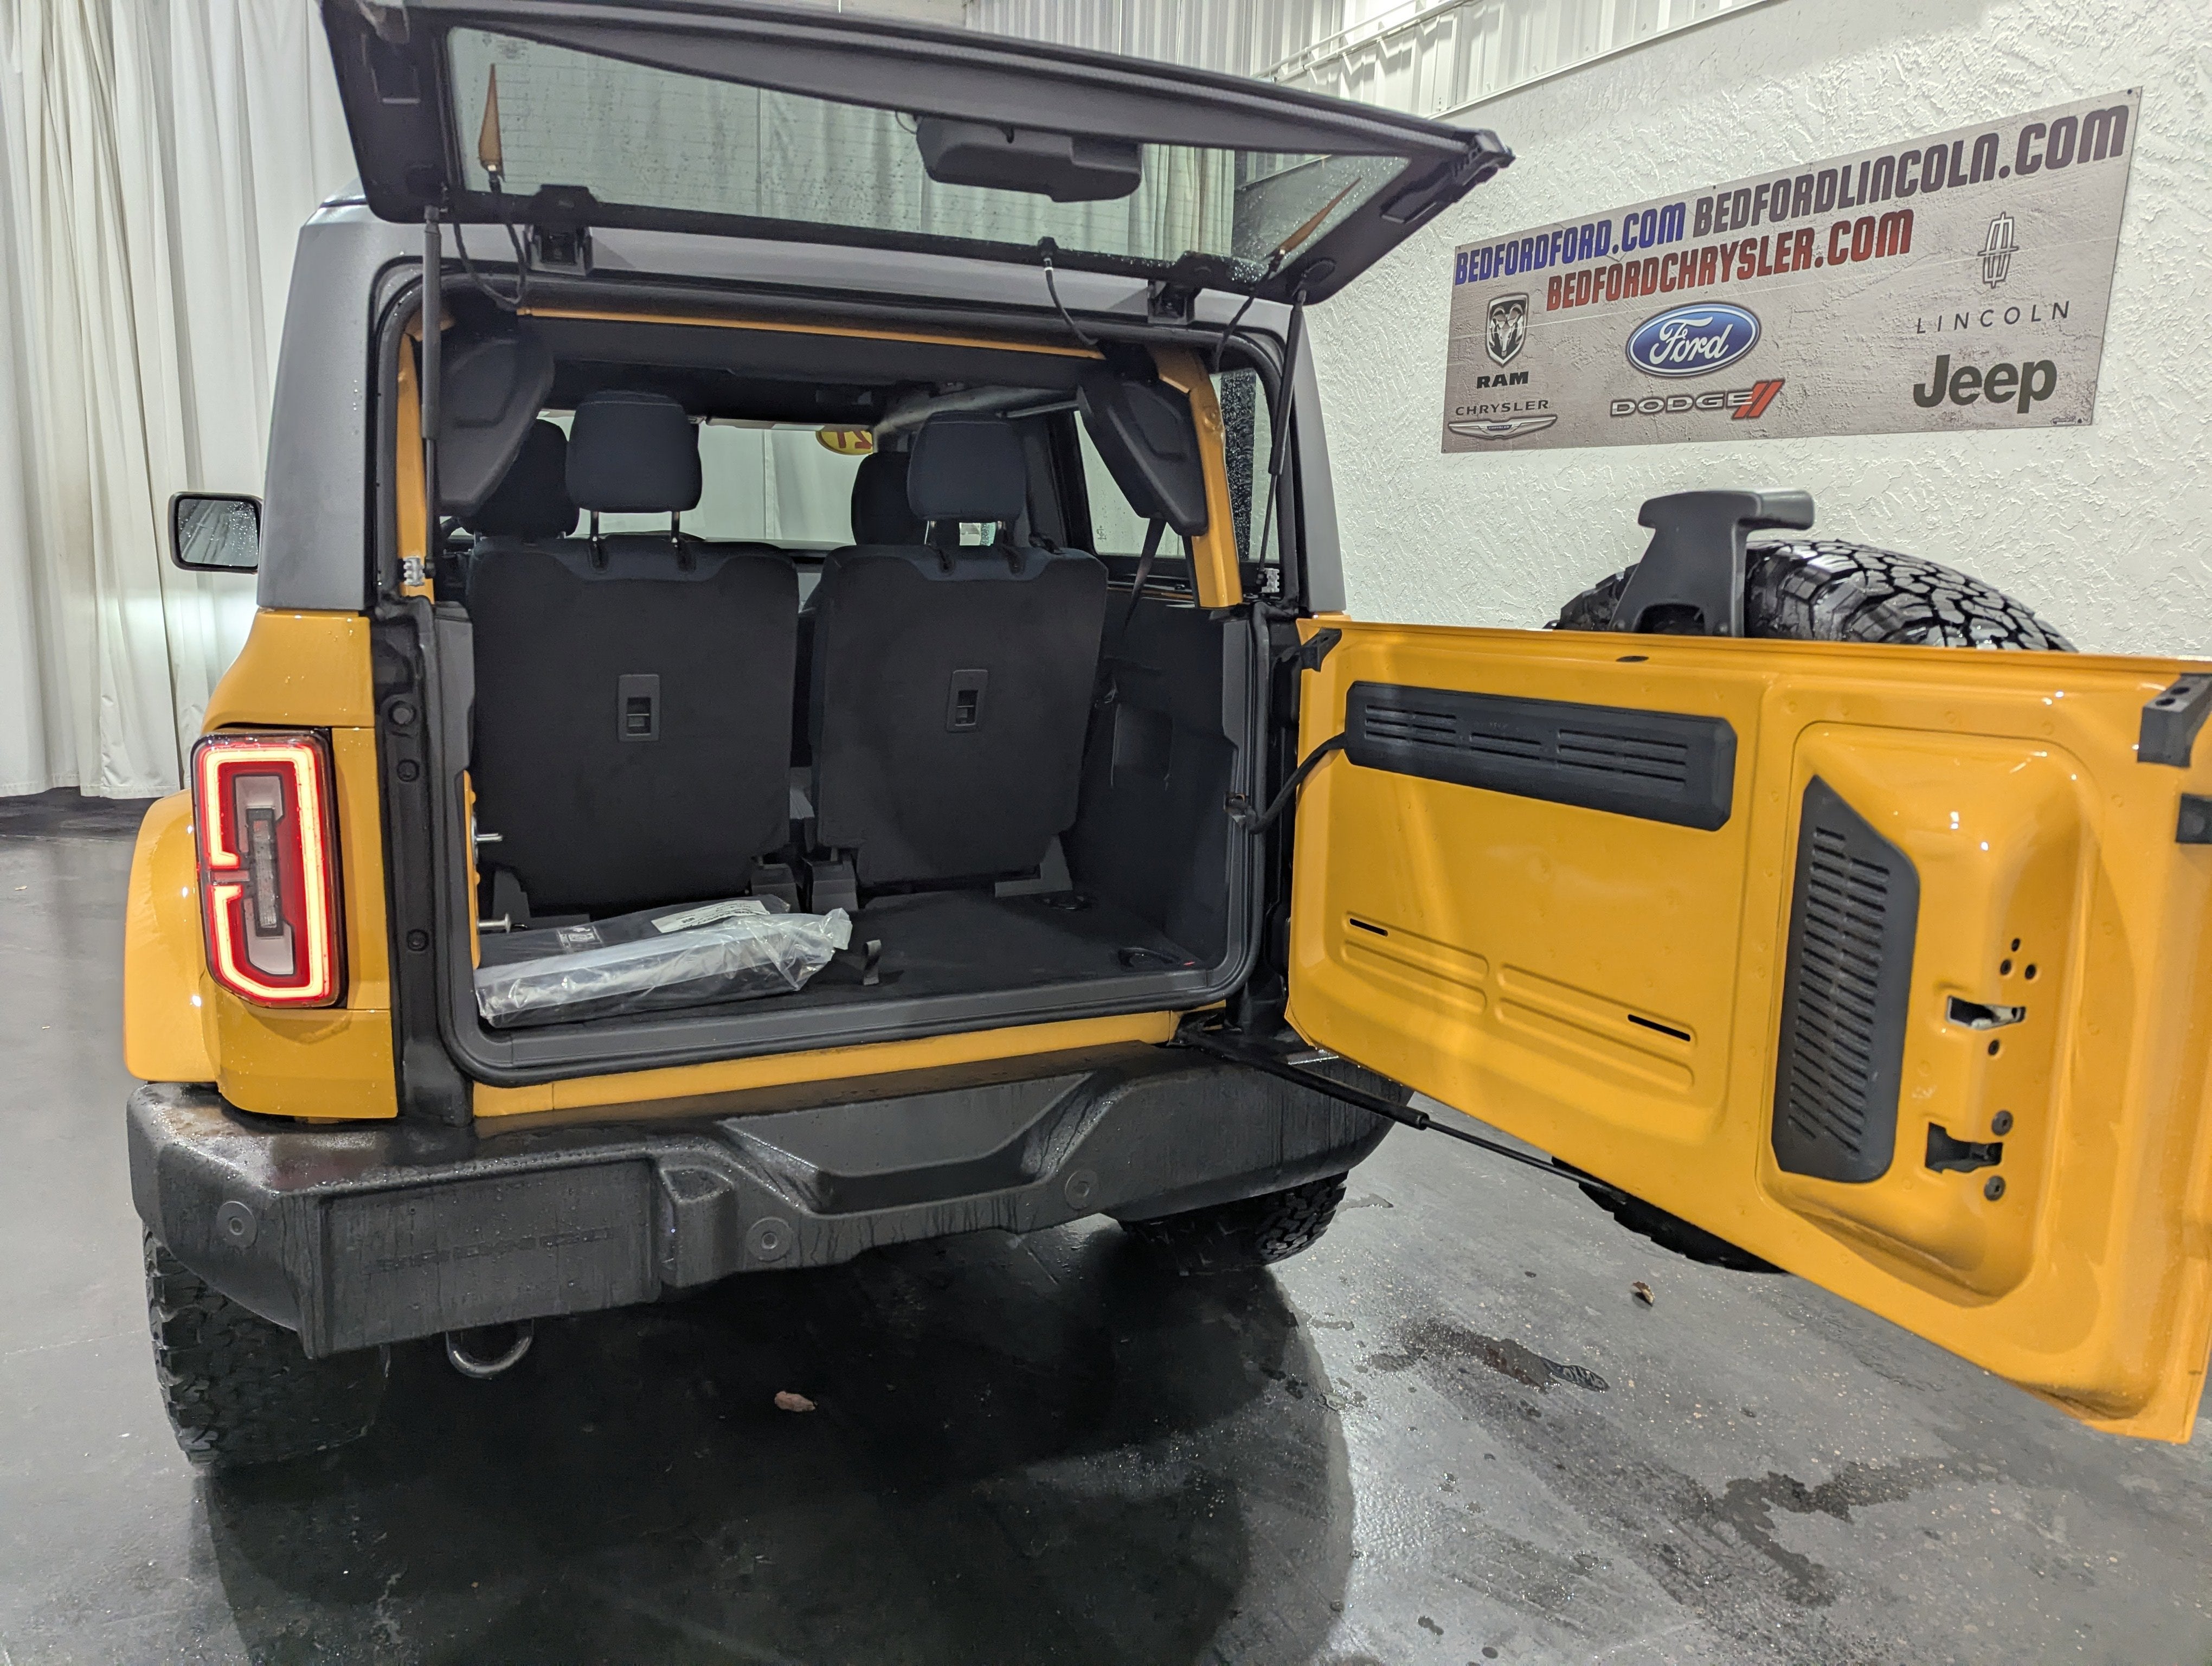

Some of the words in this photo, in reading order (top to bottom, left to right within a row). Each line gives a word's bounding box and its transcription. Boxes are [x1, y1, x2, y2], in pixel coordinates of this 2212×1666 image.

[1455, 202, 1686, 285] BEDFORDFORD.COM
[1693, 105, 2129, 238] BEDFORDLINCOLN.COM
[1547, 209, 1914, 311] BEDFORDCHRYSLER.COM
[1917, 300, 2069, 334] LINCOLN
[1649, 316, 1733, 364] Ford
[1477, 371, 1529, 389] RAM
[1913, 354, 2057, 414] Jeep
[1456, 400, 1548, 415] CHRYSLER
[1611, 391, 1753, 415] DODGE
